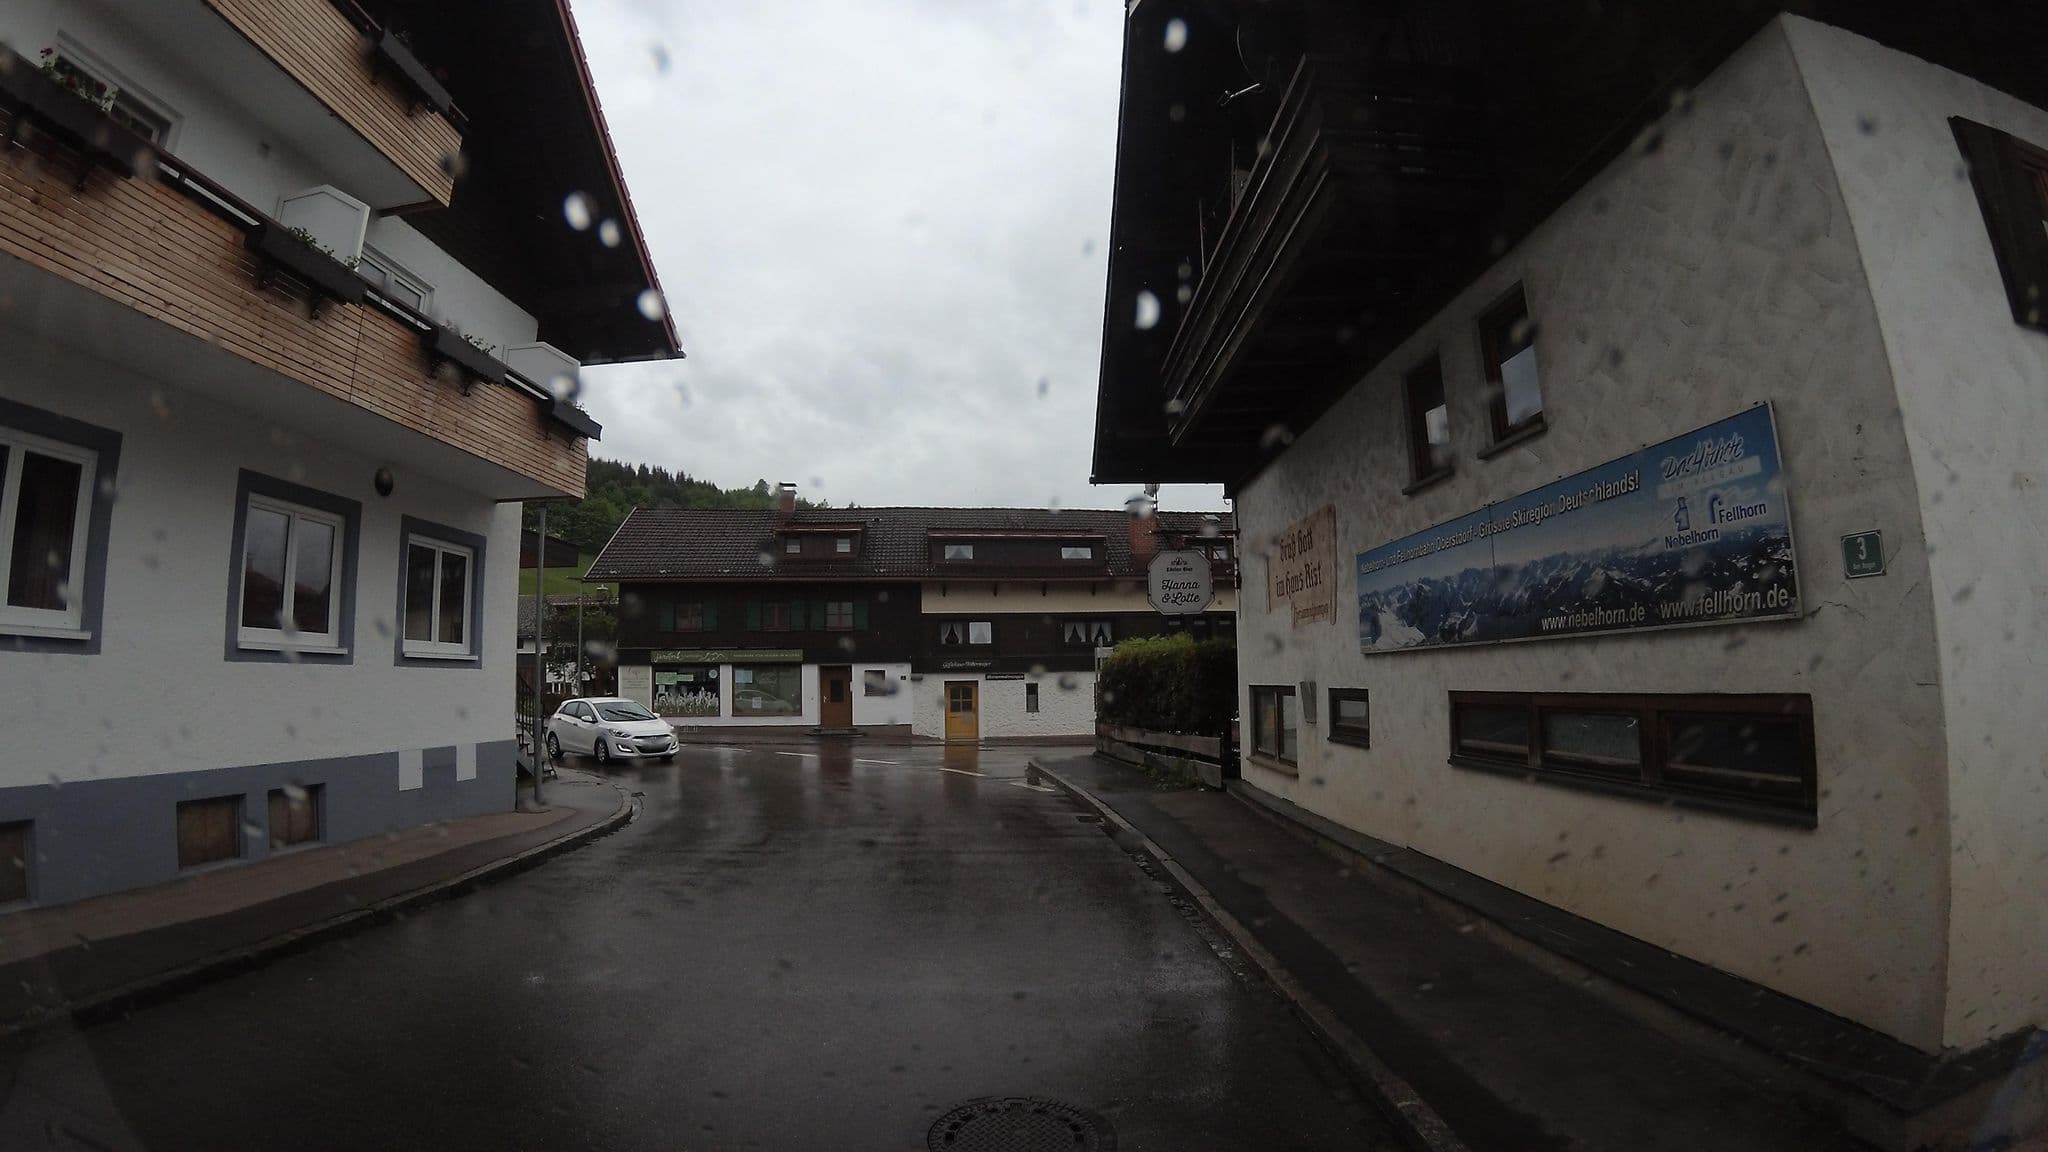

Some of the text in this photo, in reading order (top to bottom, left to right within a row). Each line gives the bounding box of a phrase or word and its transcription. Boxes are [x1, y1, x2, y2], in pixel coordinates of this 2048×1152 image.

[1558, 469, 1640, 514] Deutschlands!
[1718, 502, 1768, 524] Fellhorn
[1664, 529, 1720, 550] Nebelhorn
[1856, 537, 1867, 560] 3
[1161, 579, 1201, 591] Hanna
[1304, 561, 1322, 589] Rist
[1161, 592, 1201, 606] & Lotte
[1660, 584, 1789, 619] www.fellhorn.de
